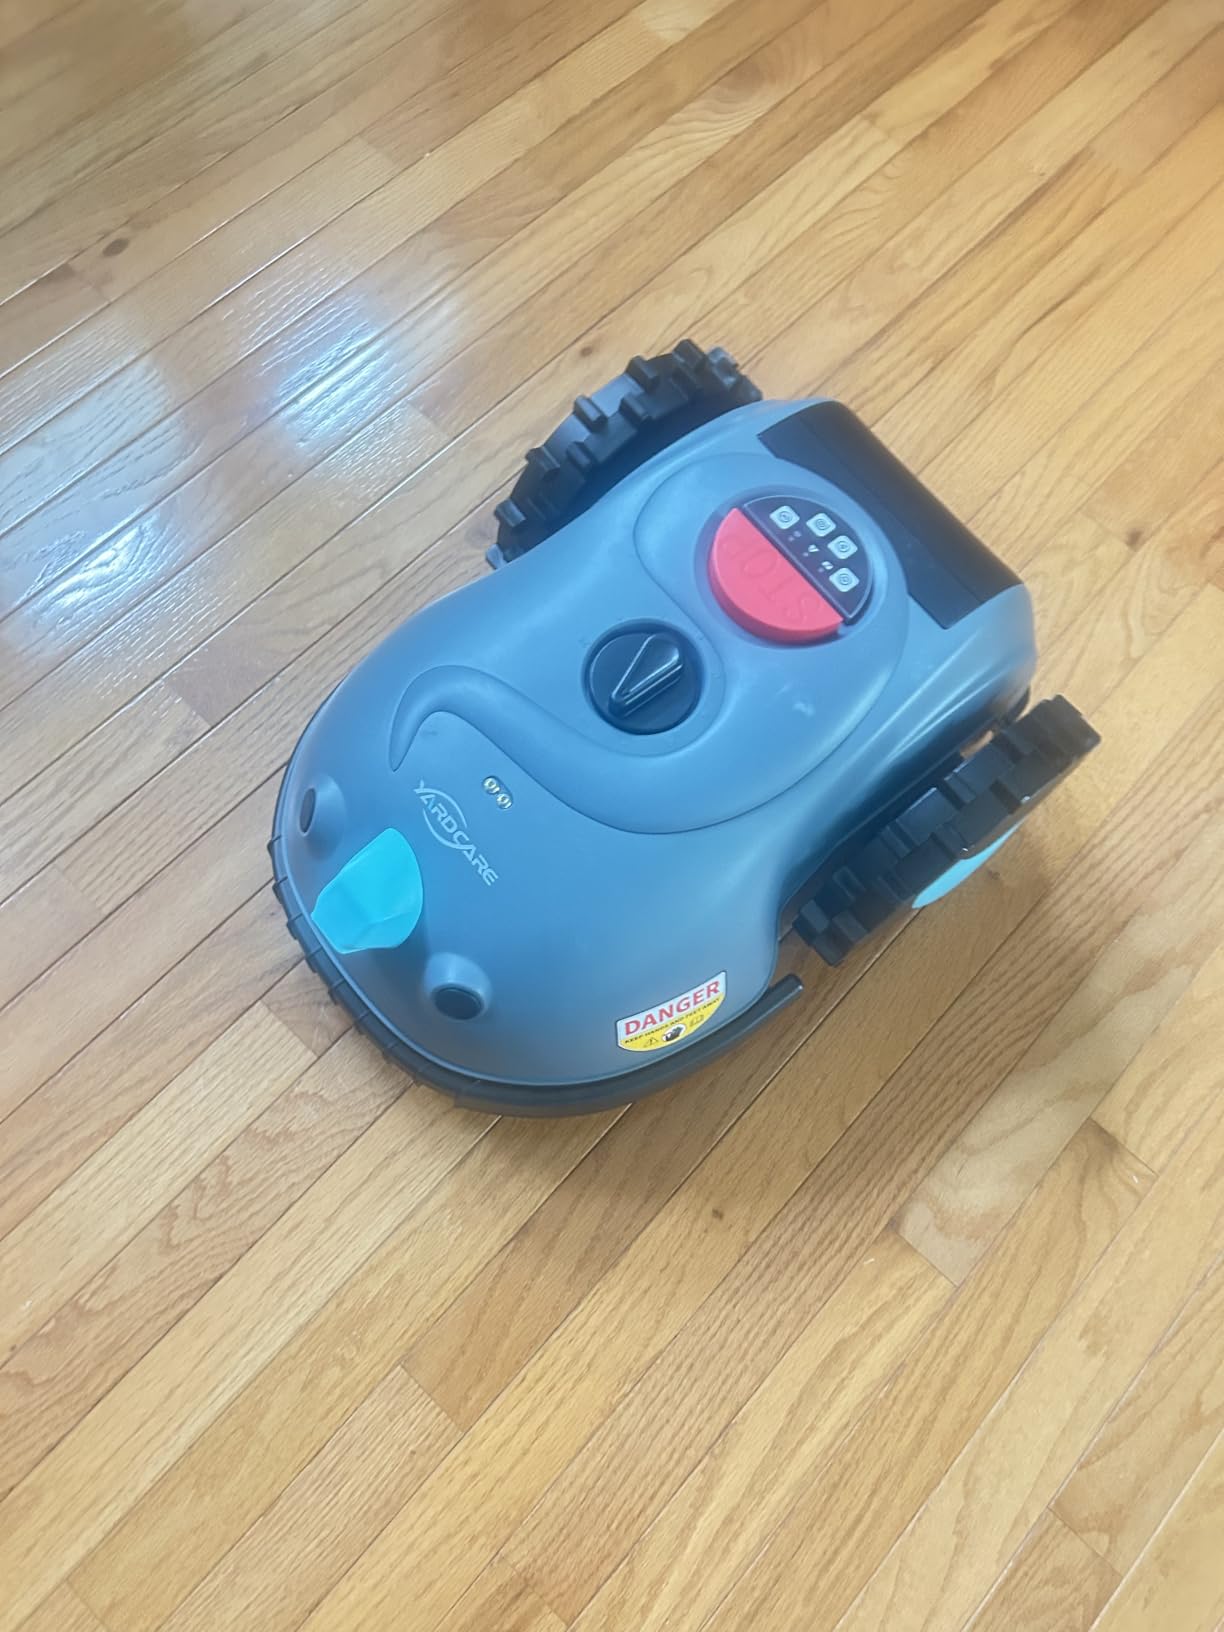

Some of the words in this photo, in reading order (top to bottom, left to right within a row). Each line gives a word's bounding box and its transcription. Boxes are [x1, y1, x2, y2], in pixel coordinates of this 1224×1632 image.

[718, 532, 825, 625] STOP
[413, 779, 499, 886] YARDCARE
[624, 980, 720, 1035] DANGER
